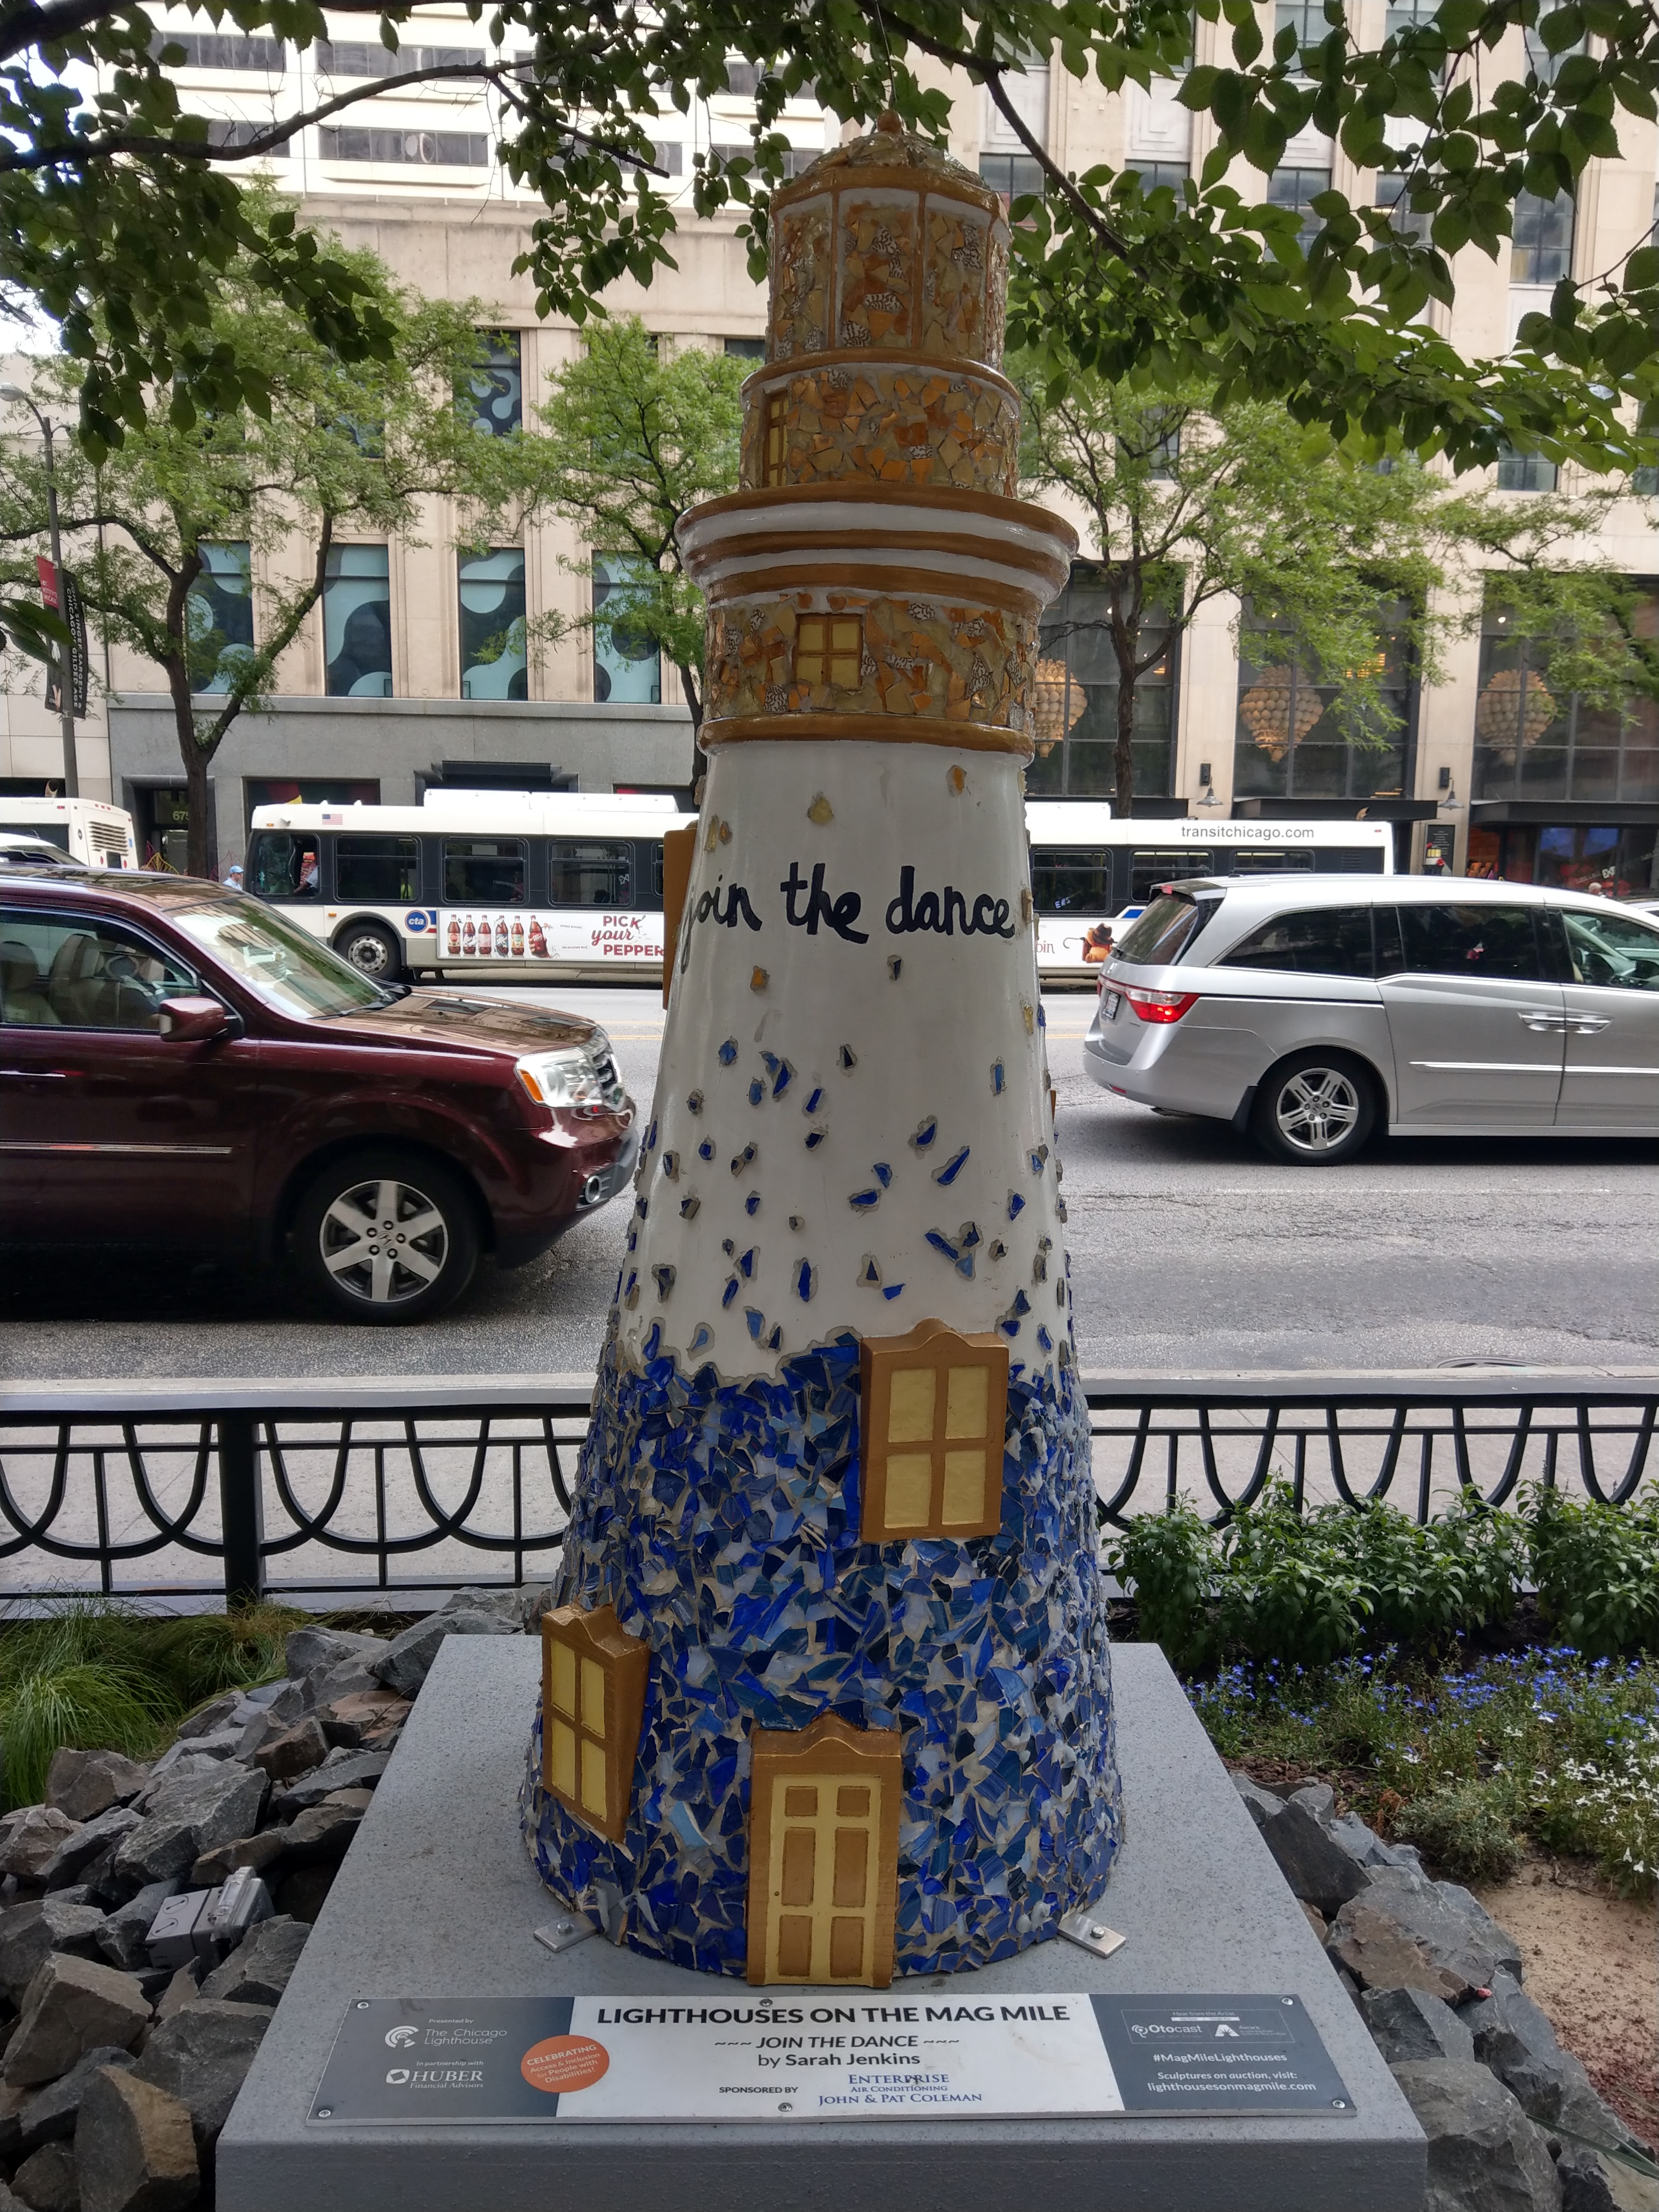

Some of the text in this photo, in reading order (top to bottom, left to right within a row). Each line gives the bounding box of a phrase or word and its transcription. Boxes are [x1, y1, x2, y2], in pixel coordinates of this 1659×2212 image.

[1181, 826, 1314, 840] transitchicago.com
[780, 862, 870, 944] the
[885, 865, 1015, 939] dance
[408, 917, 424, 926] cta
[603, 916, 641, 930] PICK
[591, 928, 634, 946] your
[603, 944, 664, 956] PEPPER
[597, 2006, 1070, 2024] LIGHTHOUSES ON THE MAG MILE
[454, 2029, 507, 2038] Chicago
[1148, 2024, 1203, 2033] Otocast
[424, 2036, 493, 2046] Lighthouse
[756, 2037, 803, 2049] JOIN
[808, 2036, 847, 2048] THE
[850, 2036, 918, 2047] DANCE
[527, 2044, 597, 2066] CELEBRATING
[757, 2052, 921, 2069] by Sarah Jenkins
[1153, 2053, 1288, 2063] #MagMileLighthouses
[530, 2062, 557, 2073] Access
[565, 2053, 600, 2065] Inclusion
[548, 2064, 578, 2075] People
[579, 2059, 598, 2068] with
[411, 2070, 484, 2082] HUBER
[545, 2067, 595, 2083] Disabilities!
[848, 2074, 950, 2084] ENTERPRISE
[1158, 2072, 1212, 2080] Sculptures
[1272, 2071, 1298, 2079] visit:
[1147, 2082, 1317, 2092] lighthousesonmagmile.com
[819, 2093, 983, 2106] JOHN & PAT COLEMAN
